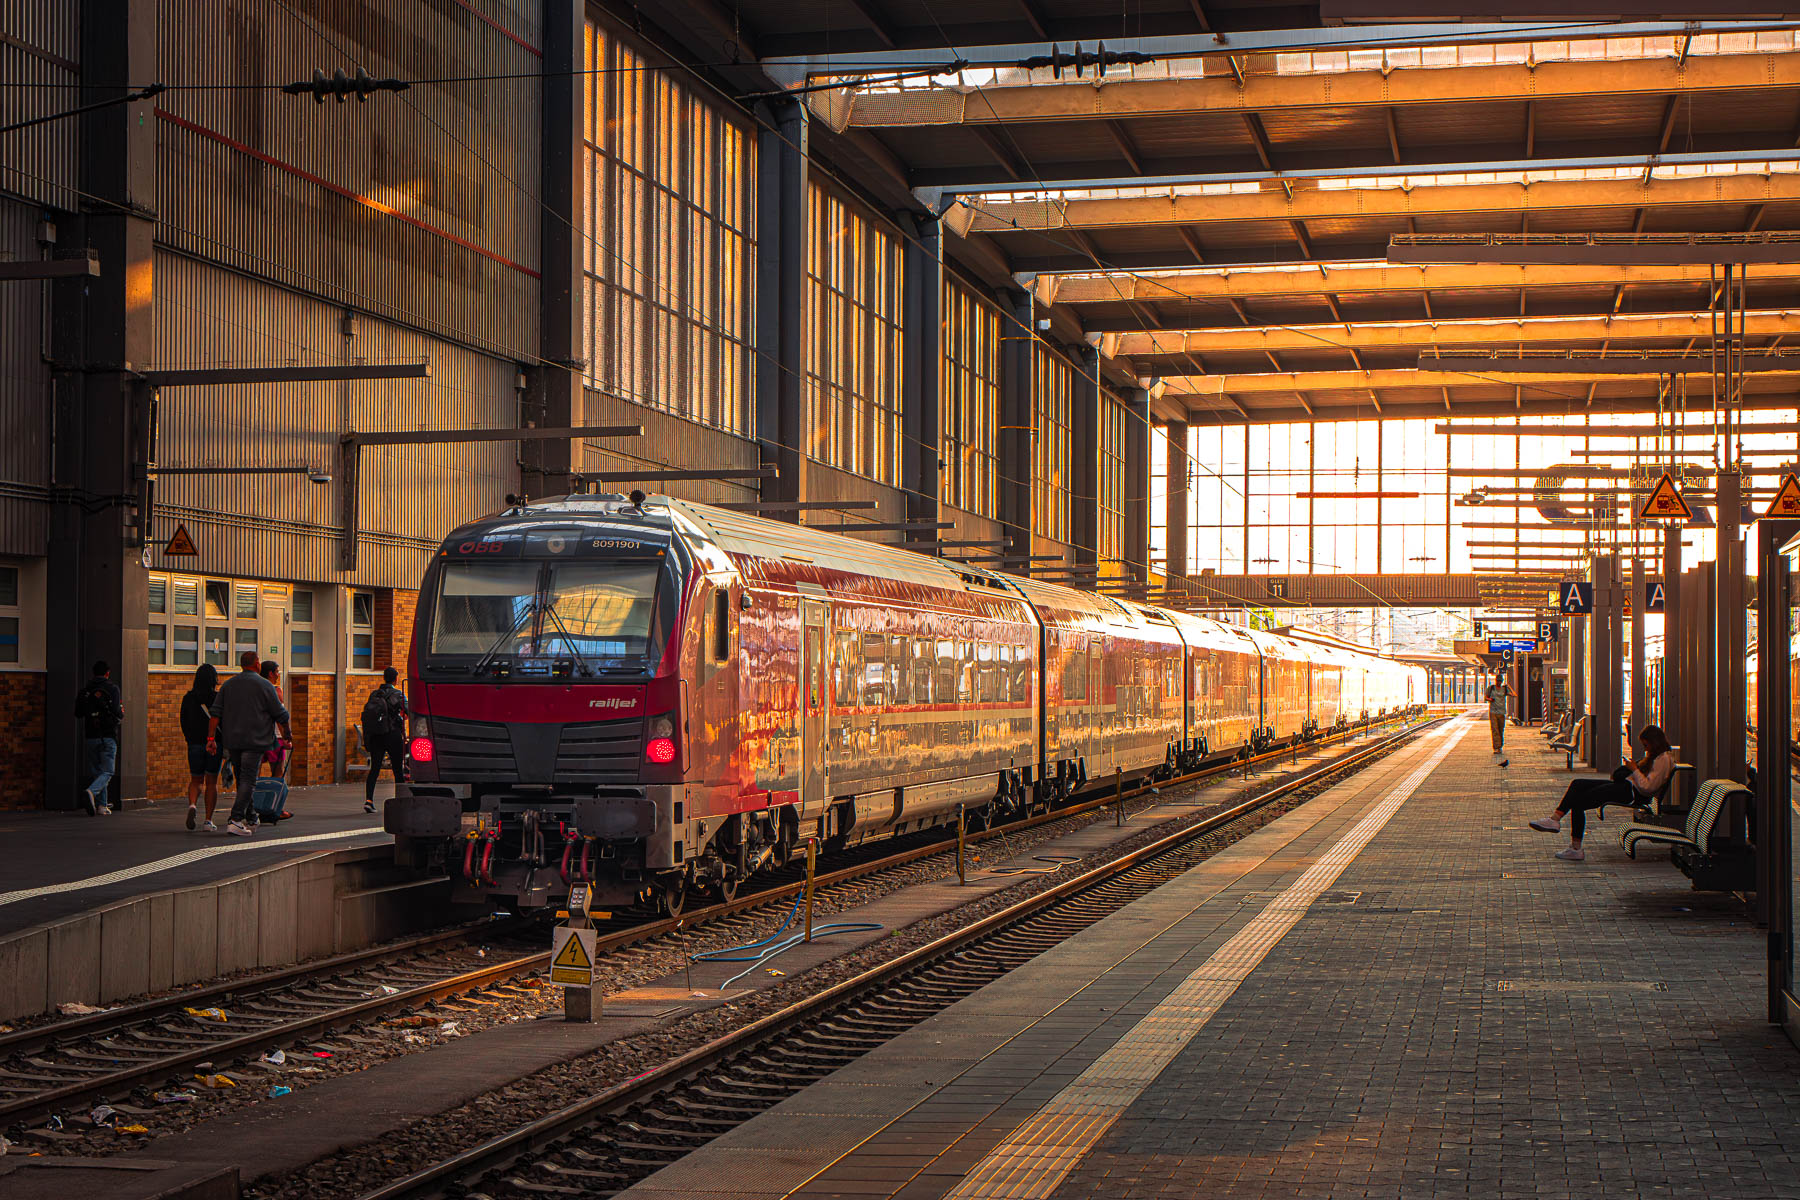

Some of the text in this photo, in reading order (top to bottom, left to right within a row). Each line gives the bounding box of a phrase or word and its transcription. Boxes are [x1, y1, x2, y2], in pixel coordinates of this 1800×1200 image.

[592, 540, 641, 549] 8091901
[1273, 584, 1282, 596] 11
[1565, 583, 1584, 607] A
[1649, 583, 1665, 607] A
[1540, 624, 1551, 638] B
[1503, 649, 1511, 660] C
[589, 698, 638, 709] railjet
